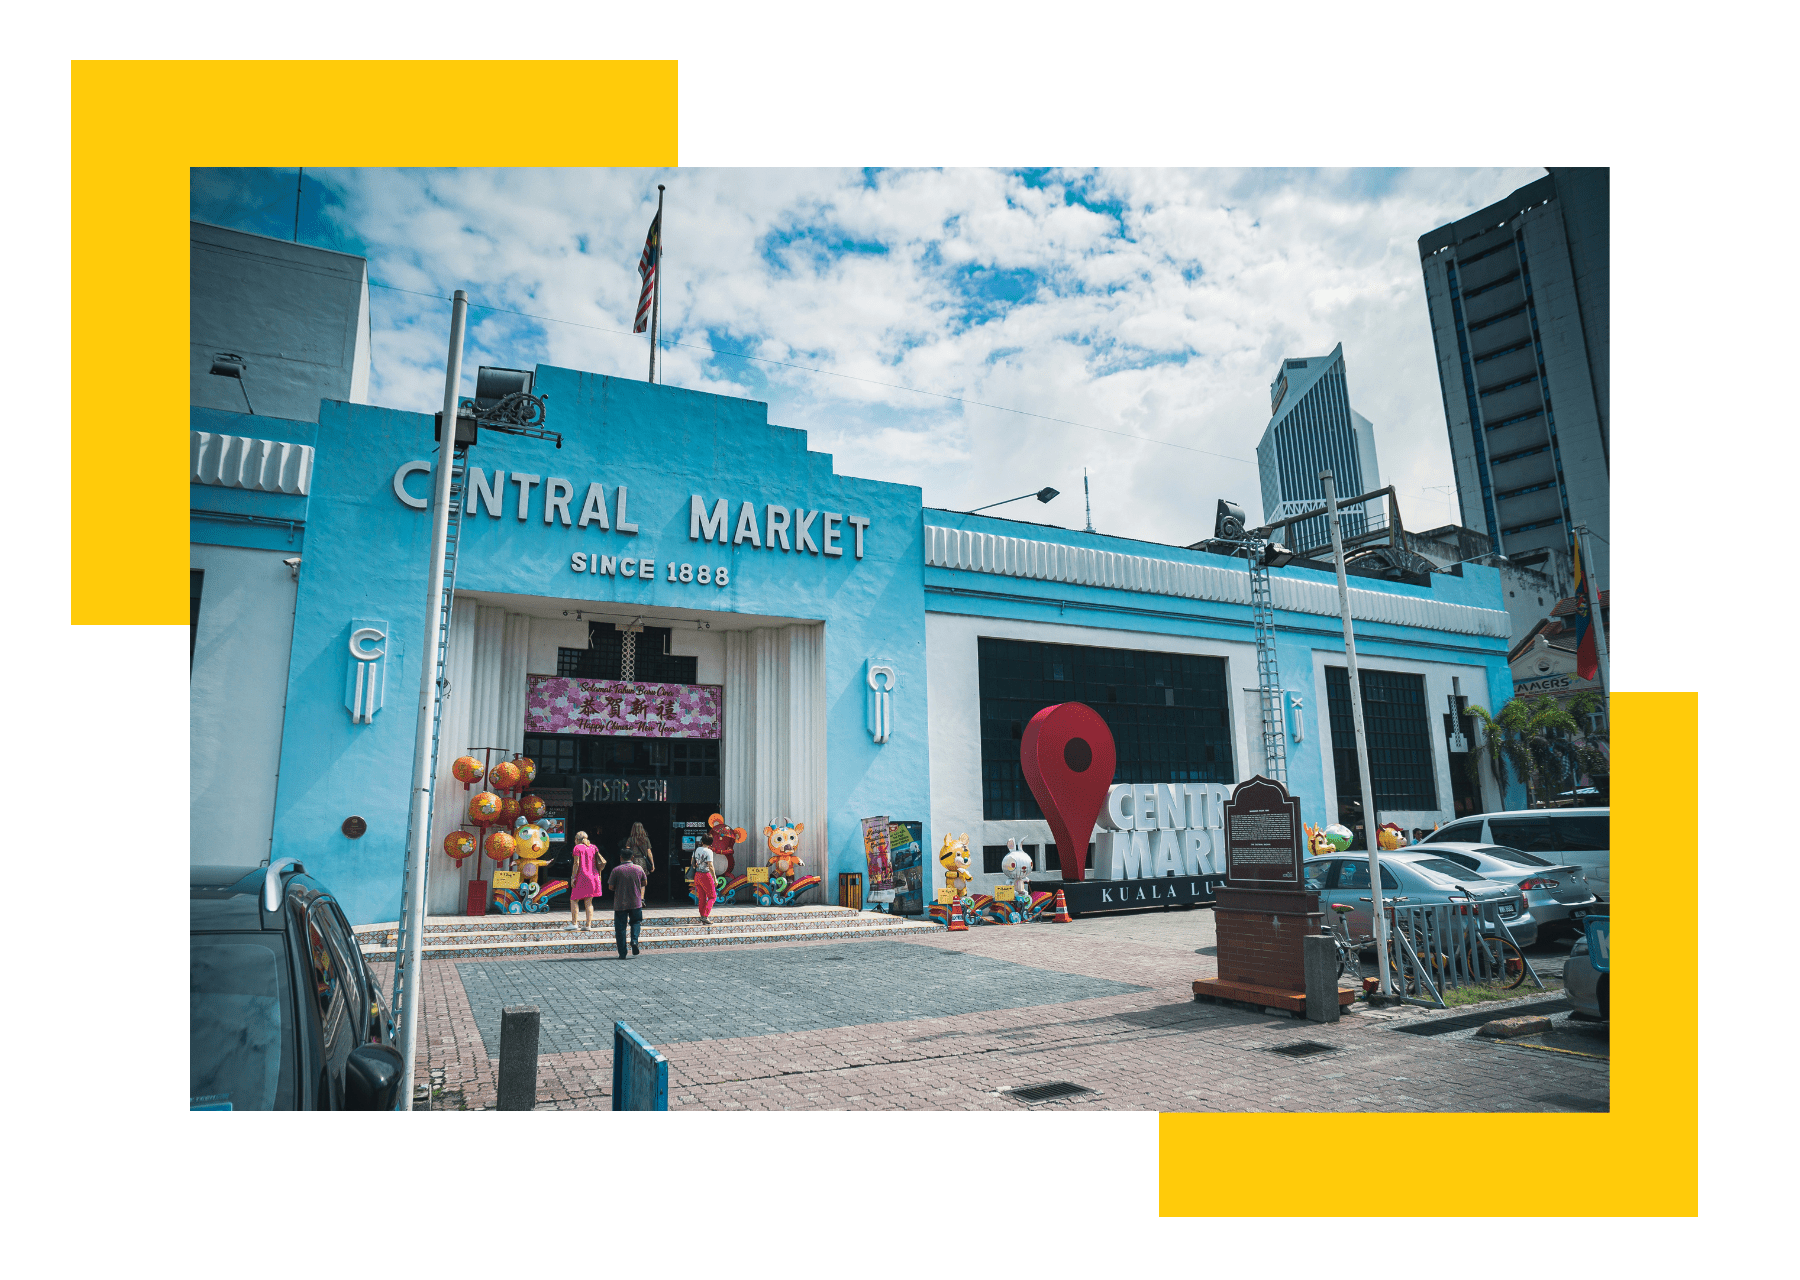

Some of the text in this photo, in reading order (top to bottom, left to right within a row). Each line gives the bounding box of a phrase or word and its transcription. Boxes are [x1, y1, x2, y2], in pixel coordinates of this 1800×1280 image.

[689, 494, 870, 559] MARKET
[570, 551, 730, 587] SINCE 1888
[579, 697, 676, 720] 恭賀新禧
[578, 720, 604, 732] Happy
[605, 719, 634, 731] Chinese
[635, 721, 654, 732] New
[582, 777, 668, 802] PASAR SENI
[1101, 880, 1227, 903] KUALA LU
